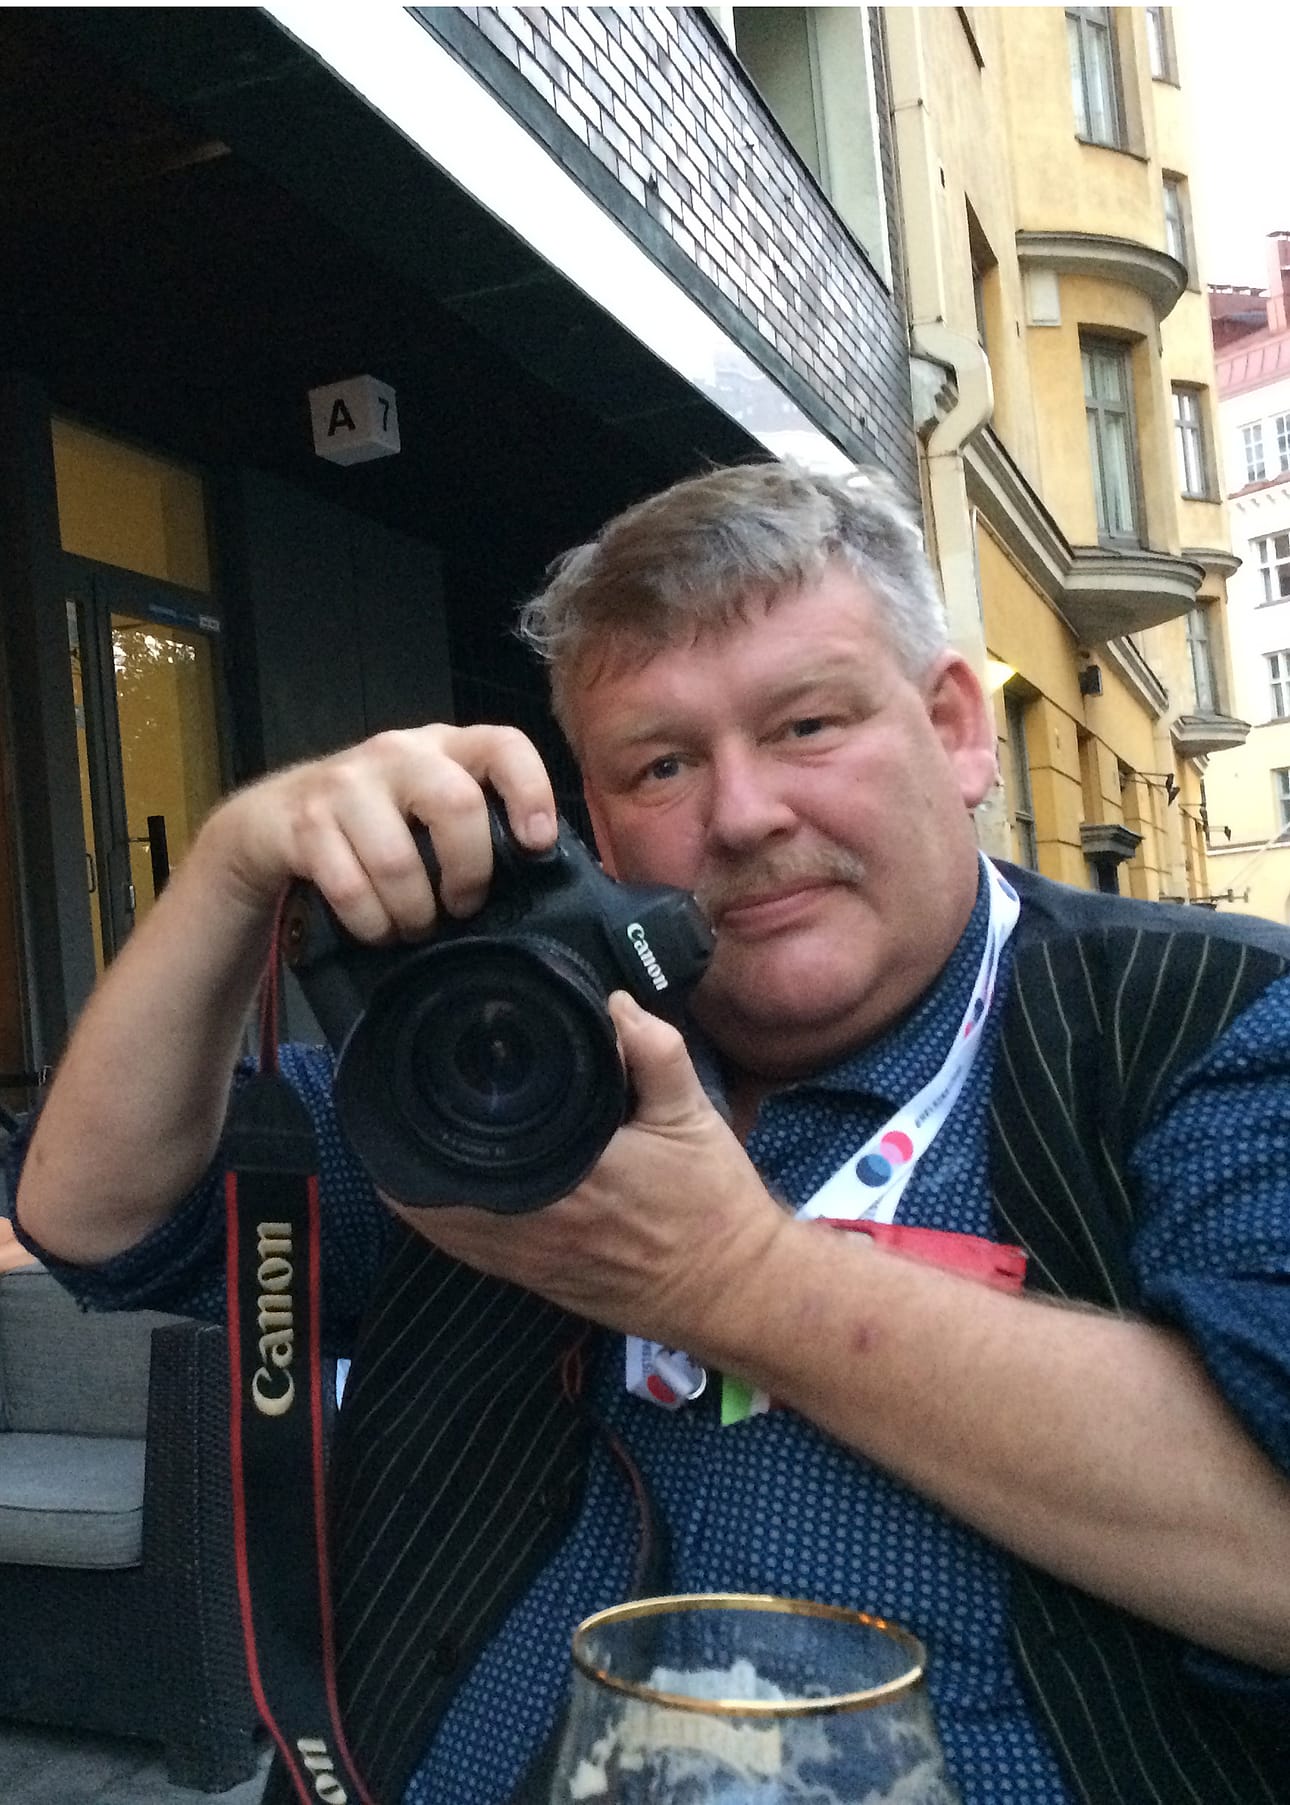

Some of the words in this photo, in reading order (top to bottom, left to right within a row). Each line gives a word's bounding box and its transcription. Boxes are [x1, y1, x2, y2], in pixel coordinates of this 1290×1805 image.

[328, 399, 356, 436] A
[378, 397, 389, 432] 7
[627, 922, 668, 991] Canon
[252, 1222, 295, 1416] Canon
